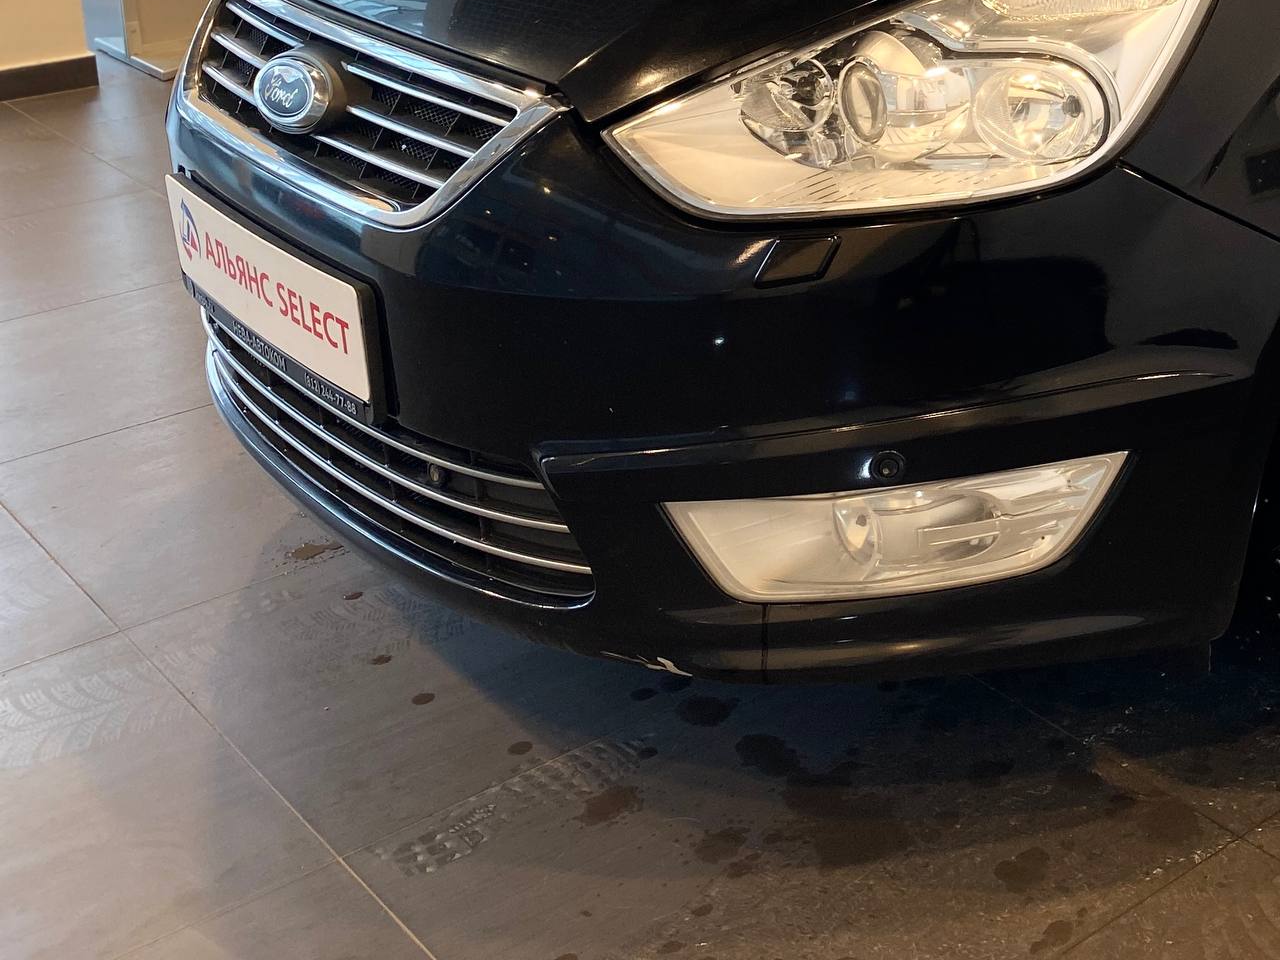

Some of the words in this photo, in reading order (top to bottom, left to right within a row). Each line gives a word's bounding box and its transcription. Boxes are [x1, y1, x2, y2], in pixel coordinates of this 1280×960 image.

[264, 71, 299, 109] Ford
[205, 231, 273, 308] АЛЬЯНС
[276, 282, 349, 355] SELECT
